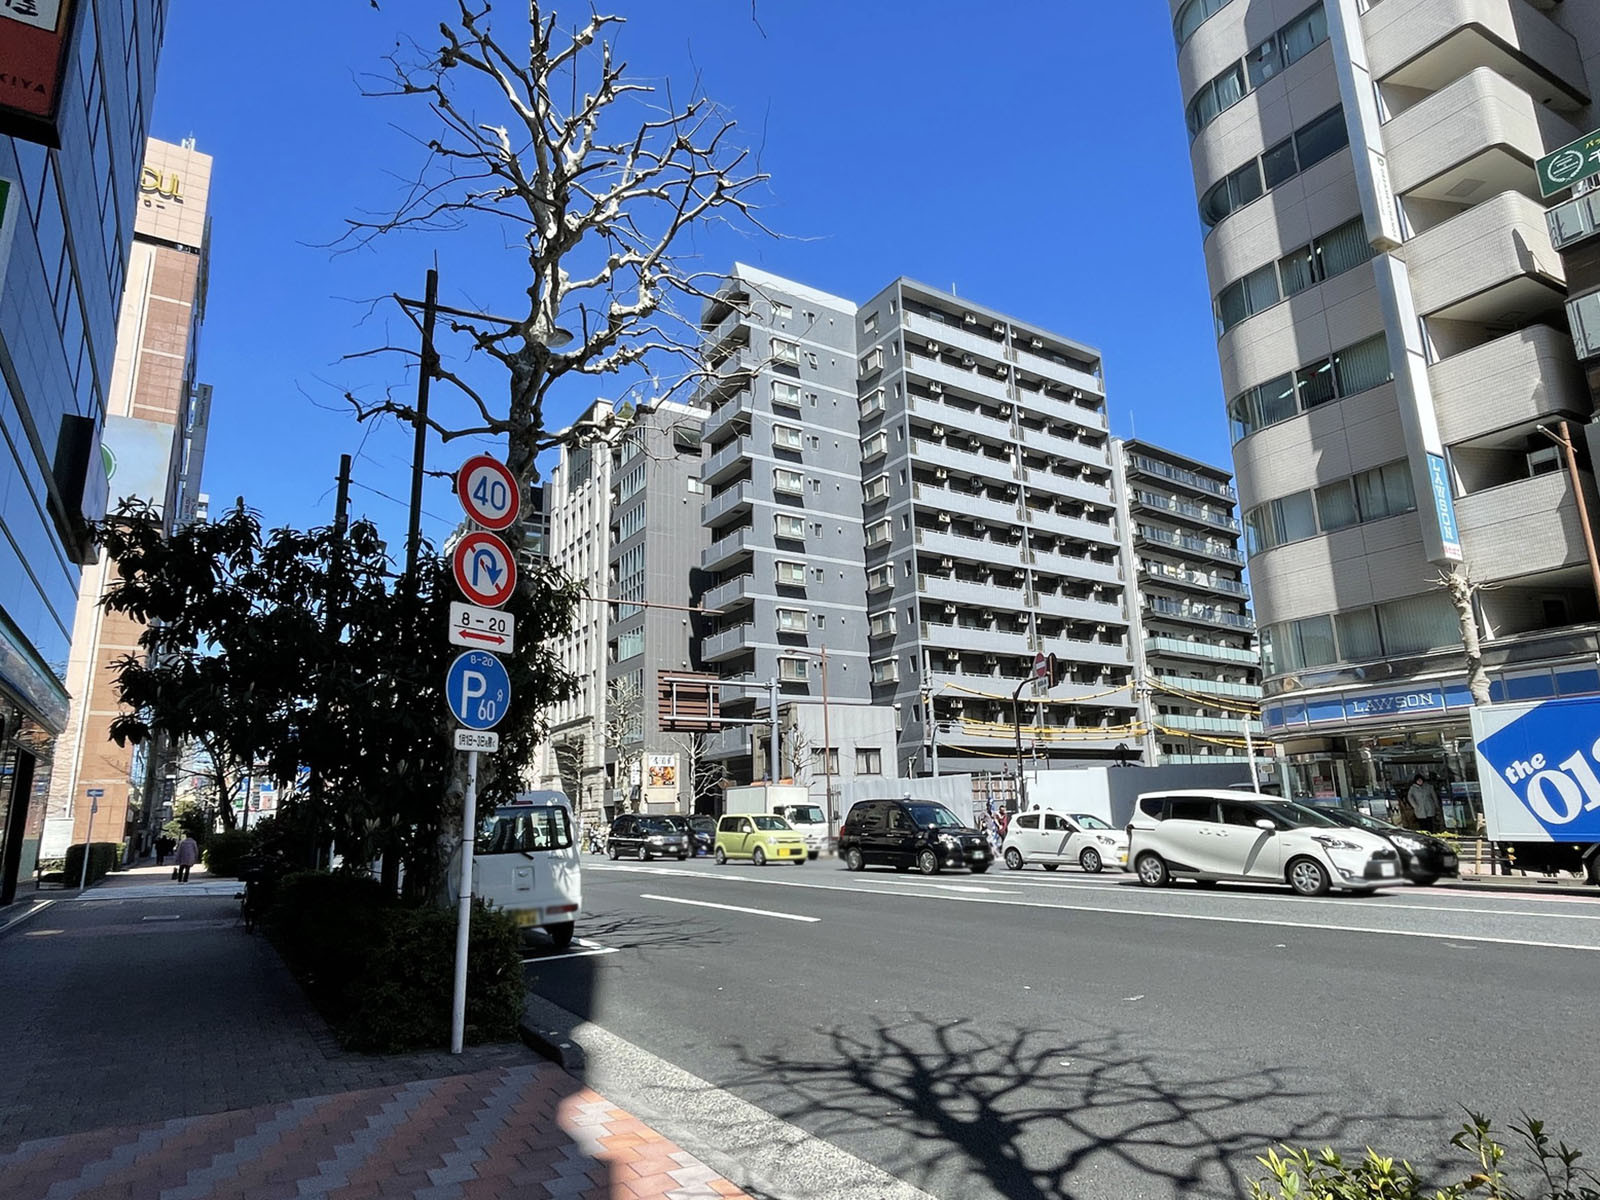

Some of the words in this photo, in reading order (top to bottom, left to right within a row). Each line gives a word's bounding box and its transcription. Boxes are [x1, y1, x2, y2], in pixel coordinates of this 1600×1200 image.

[473, 476, 506, 511] 40
[1431, 458, 1454, 540] LAWSON
[1352, 692, 1434, 713] LAWSON
[1505, 753, 1546, 784] the
[1527, 736, 1600, 825] 01
